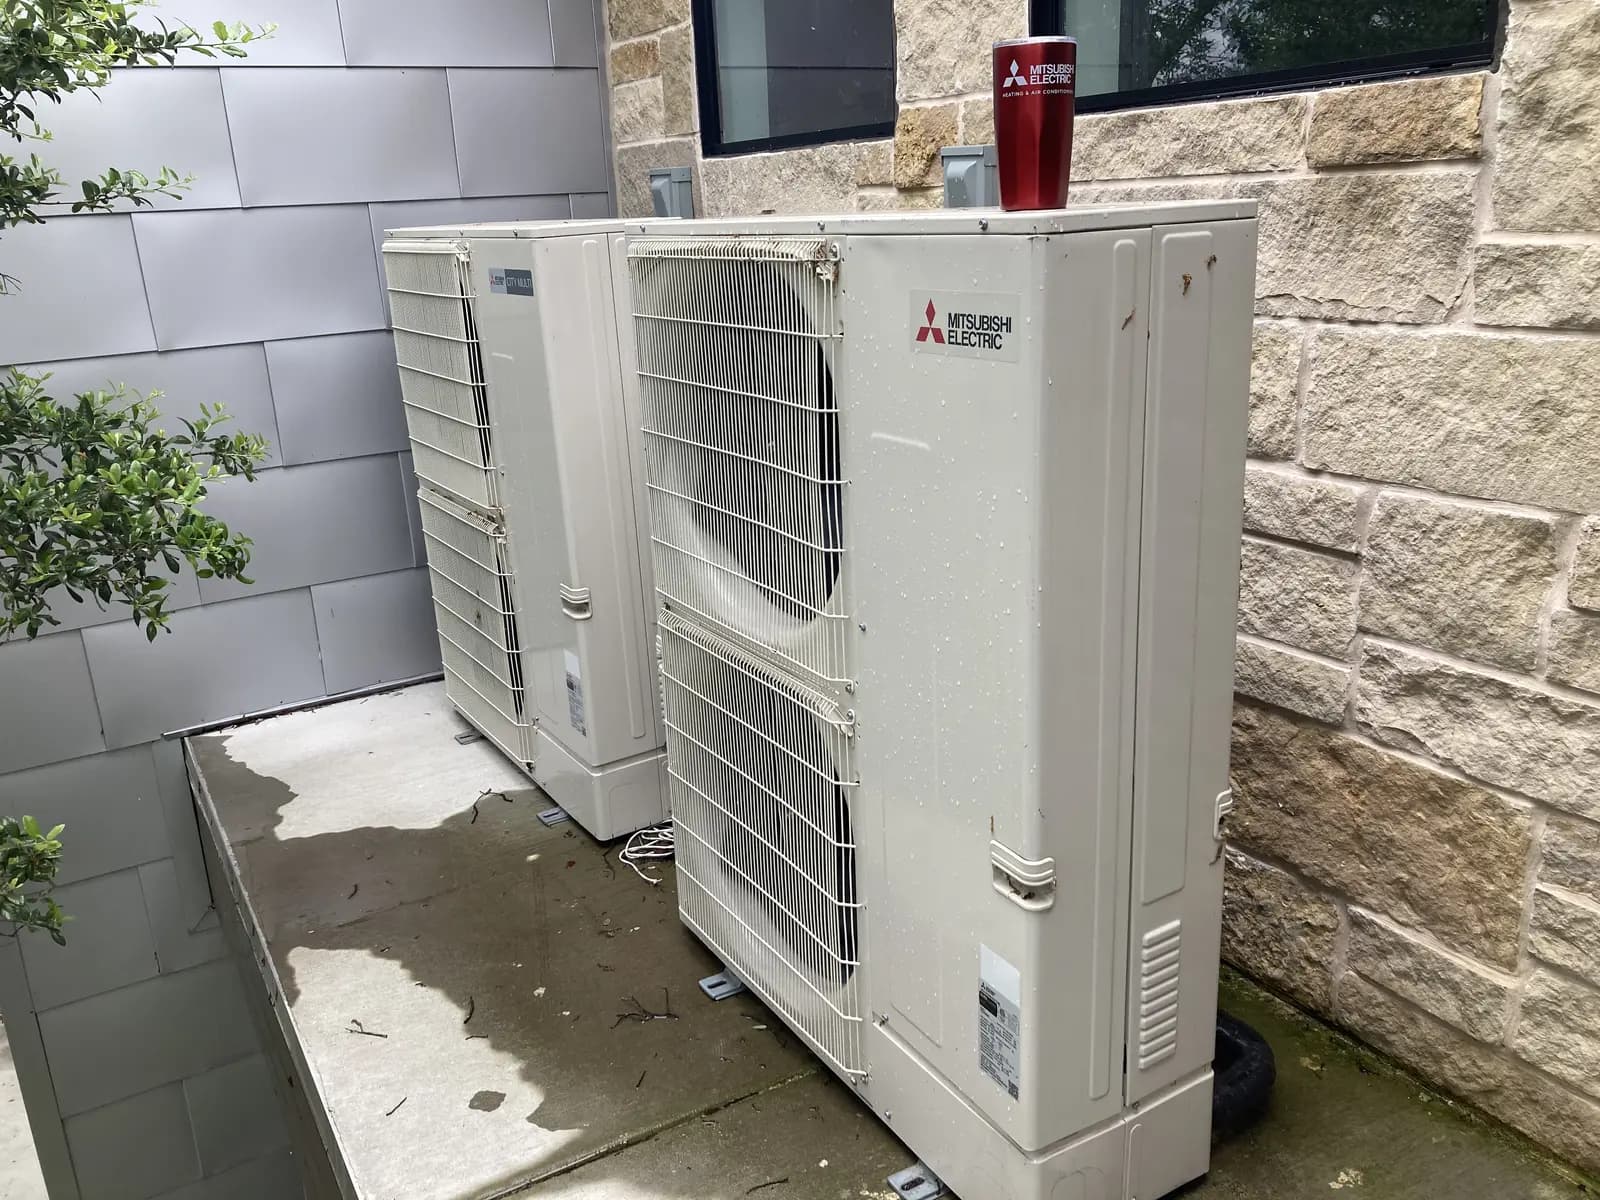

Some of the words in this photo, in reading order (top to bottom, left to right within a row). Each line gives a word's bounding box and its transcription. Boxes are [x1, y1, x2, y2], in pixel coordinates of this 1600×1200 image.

[1030, 64, 1074, 75] MITSUBISH
[1030, 74, 1071, 85] ELECTRIC
[1002, 90, 1023, 98] HEATING
[948, 312, 1012, 333] MITSUBISHI
[948, 329, 1002, 350] ELECTRIC
